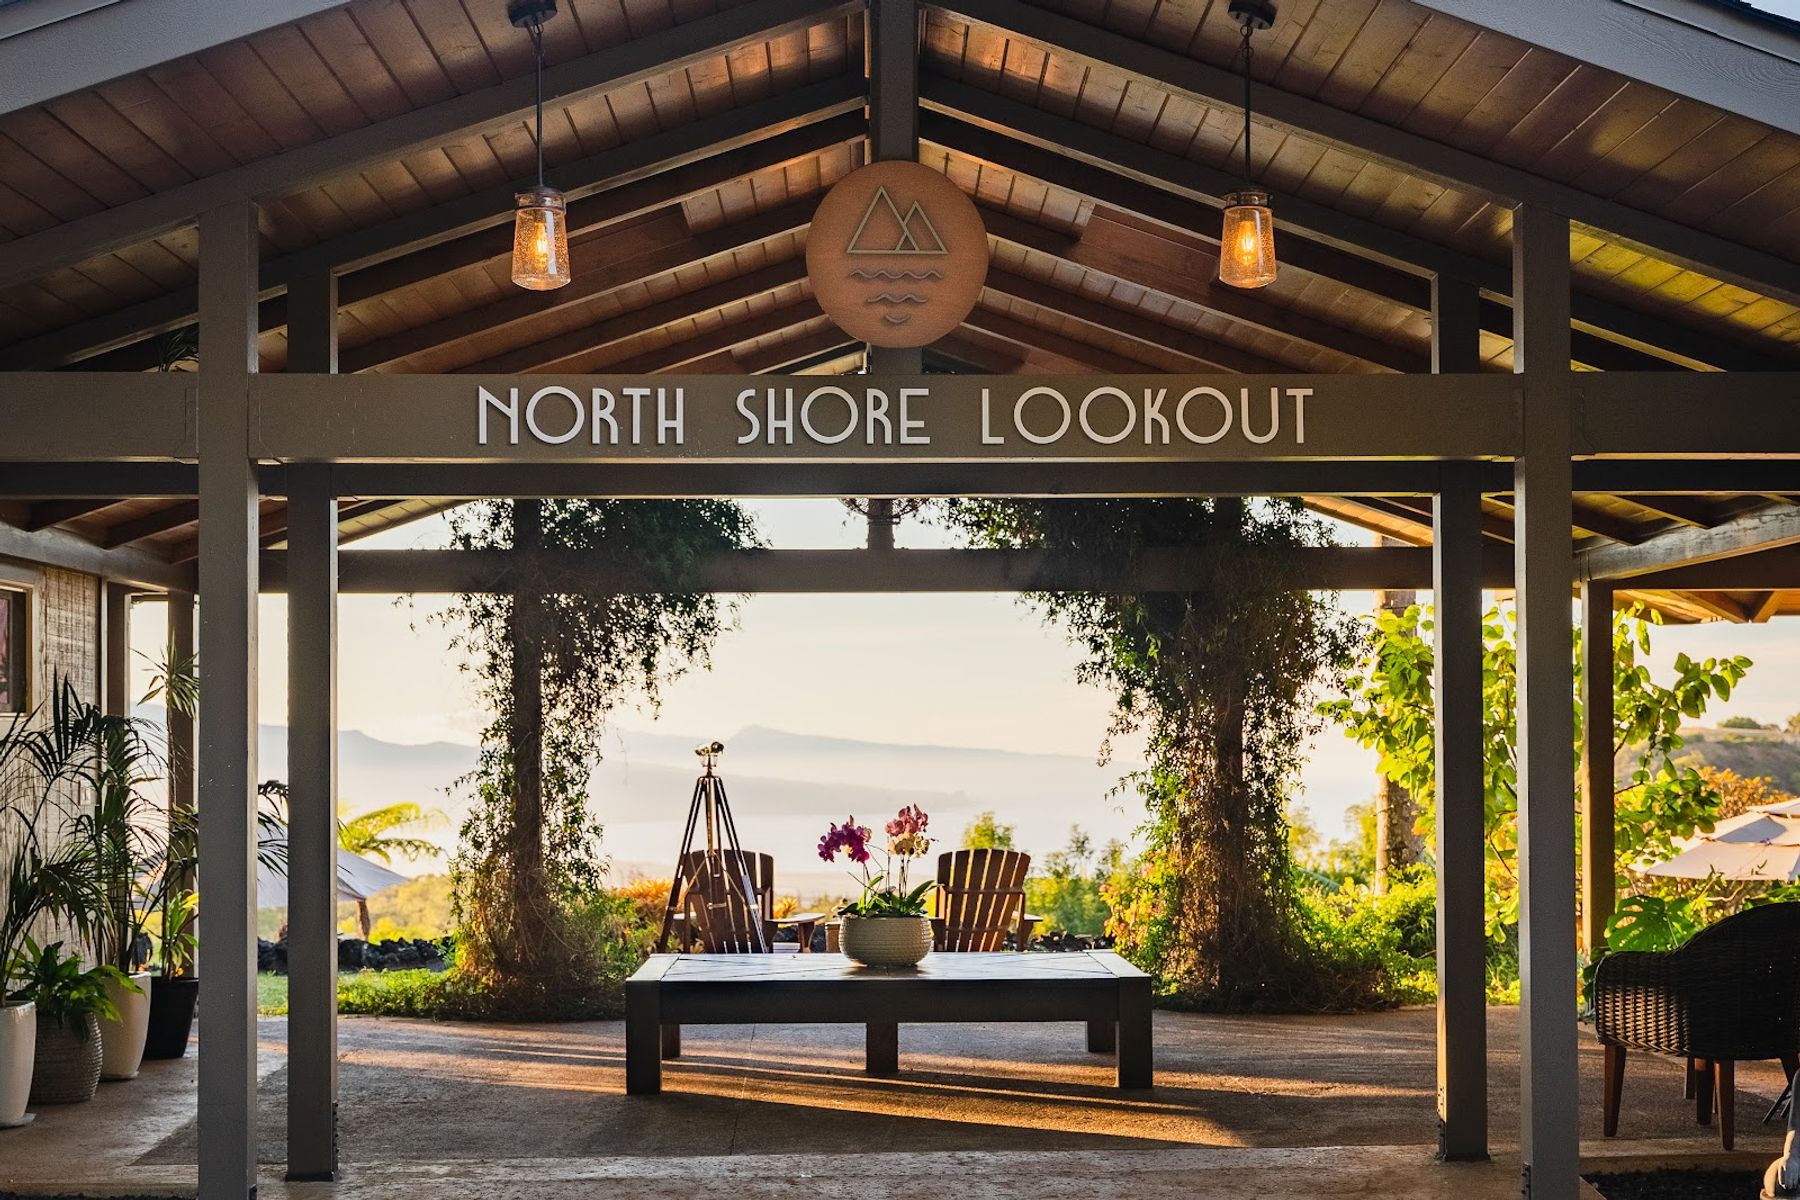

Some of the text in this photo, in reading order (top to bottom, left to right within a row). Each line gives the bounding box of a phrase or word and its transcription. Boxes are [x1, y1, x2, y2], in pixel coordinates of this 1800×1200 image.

[477, 385, 1314, 445] NORTH SHORE LOOKOUT
